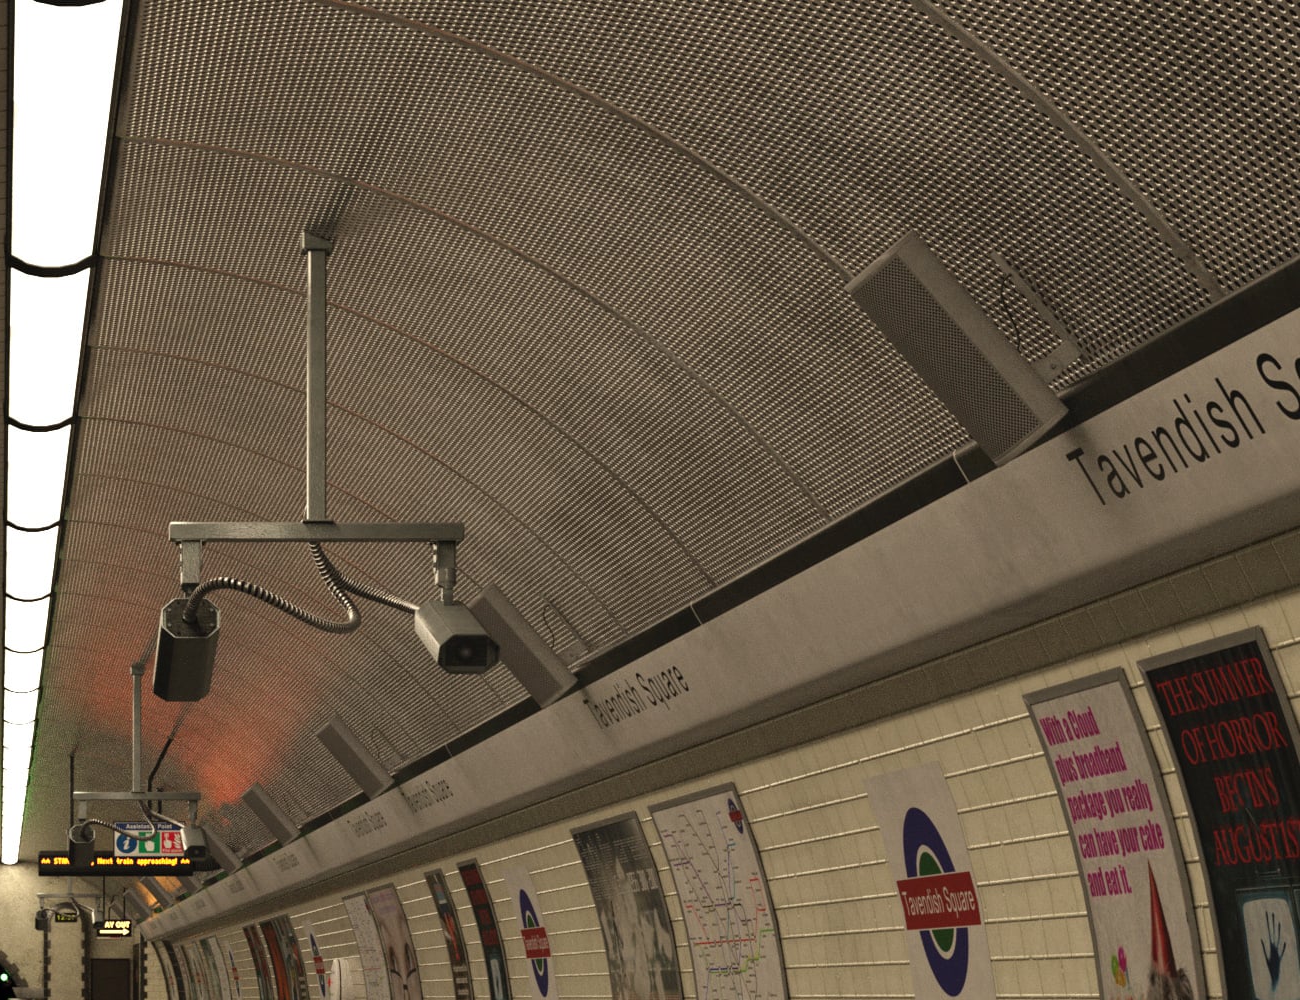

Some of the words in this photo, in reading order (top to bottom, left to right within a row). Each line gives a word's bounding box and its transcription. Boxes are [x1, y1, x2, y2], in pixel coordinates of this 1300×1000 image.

[1066, 377, 1266, 505] Tavendish
[1256, 353, 1300, 420] S
[583, 679, 647, 729] Tavendish
[636, 666, 689, 710] Square
[1156, 675, 1199, 717] THE
[1191, 657, 1274, 711] SUMMER
[1040, 715, 1067, 746] With
[1062, 718, 1074, 741] a
[1067, 705, 1100, 739] Cloud
[1180, 727, 1207, 766] OF
[1203, 711, 1288, 761] HORROR
[1055, 755, 1078, 786] plus
[1072, 741, 1127, 780] broadband
[1067, 790, 1107, 824] package
[1104, 787, 1125, 818] you
[1122, 779, 1153, 812] really
[1078, 833, 1097, 859] can
[1093, 827, 1119, 857] have
[1116, 826, 1140, 857] your
[1139, 819, 1164, 851] cake
[1212, 821, 1281, 866] AUGUST
[97, 857, 113, 865] Next
[116, 857, 134, 865] train
[137, 857, 178, 866] approaching!
[1087, 867, 1106, 897] and
[1106, 868, 1122, 896] eat
[1118, 864, 1132, 895] it.
[901, 888, 945, 916] Tavendish
[942, 886, 976, 919] Square
[104, 920, 115, 928] AY
[115, 920, 131, 928] OUT
